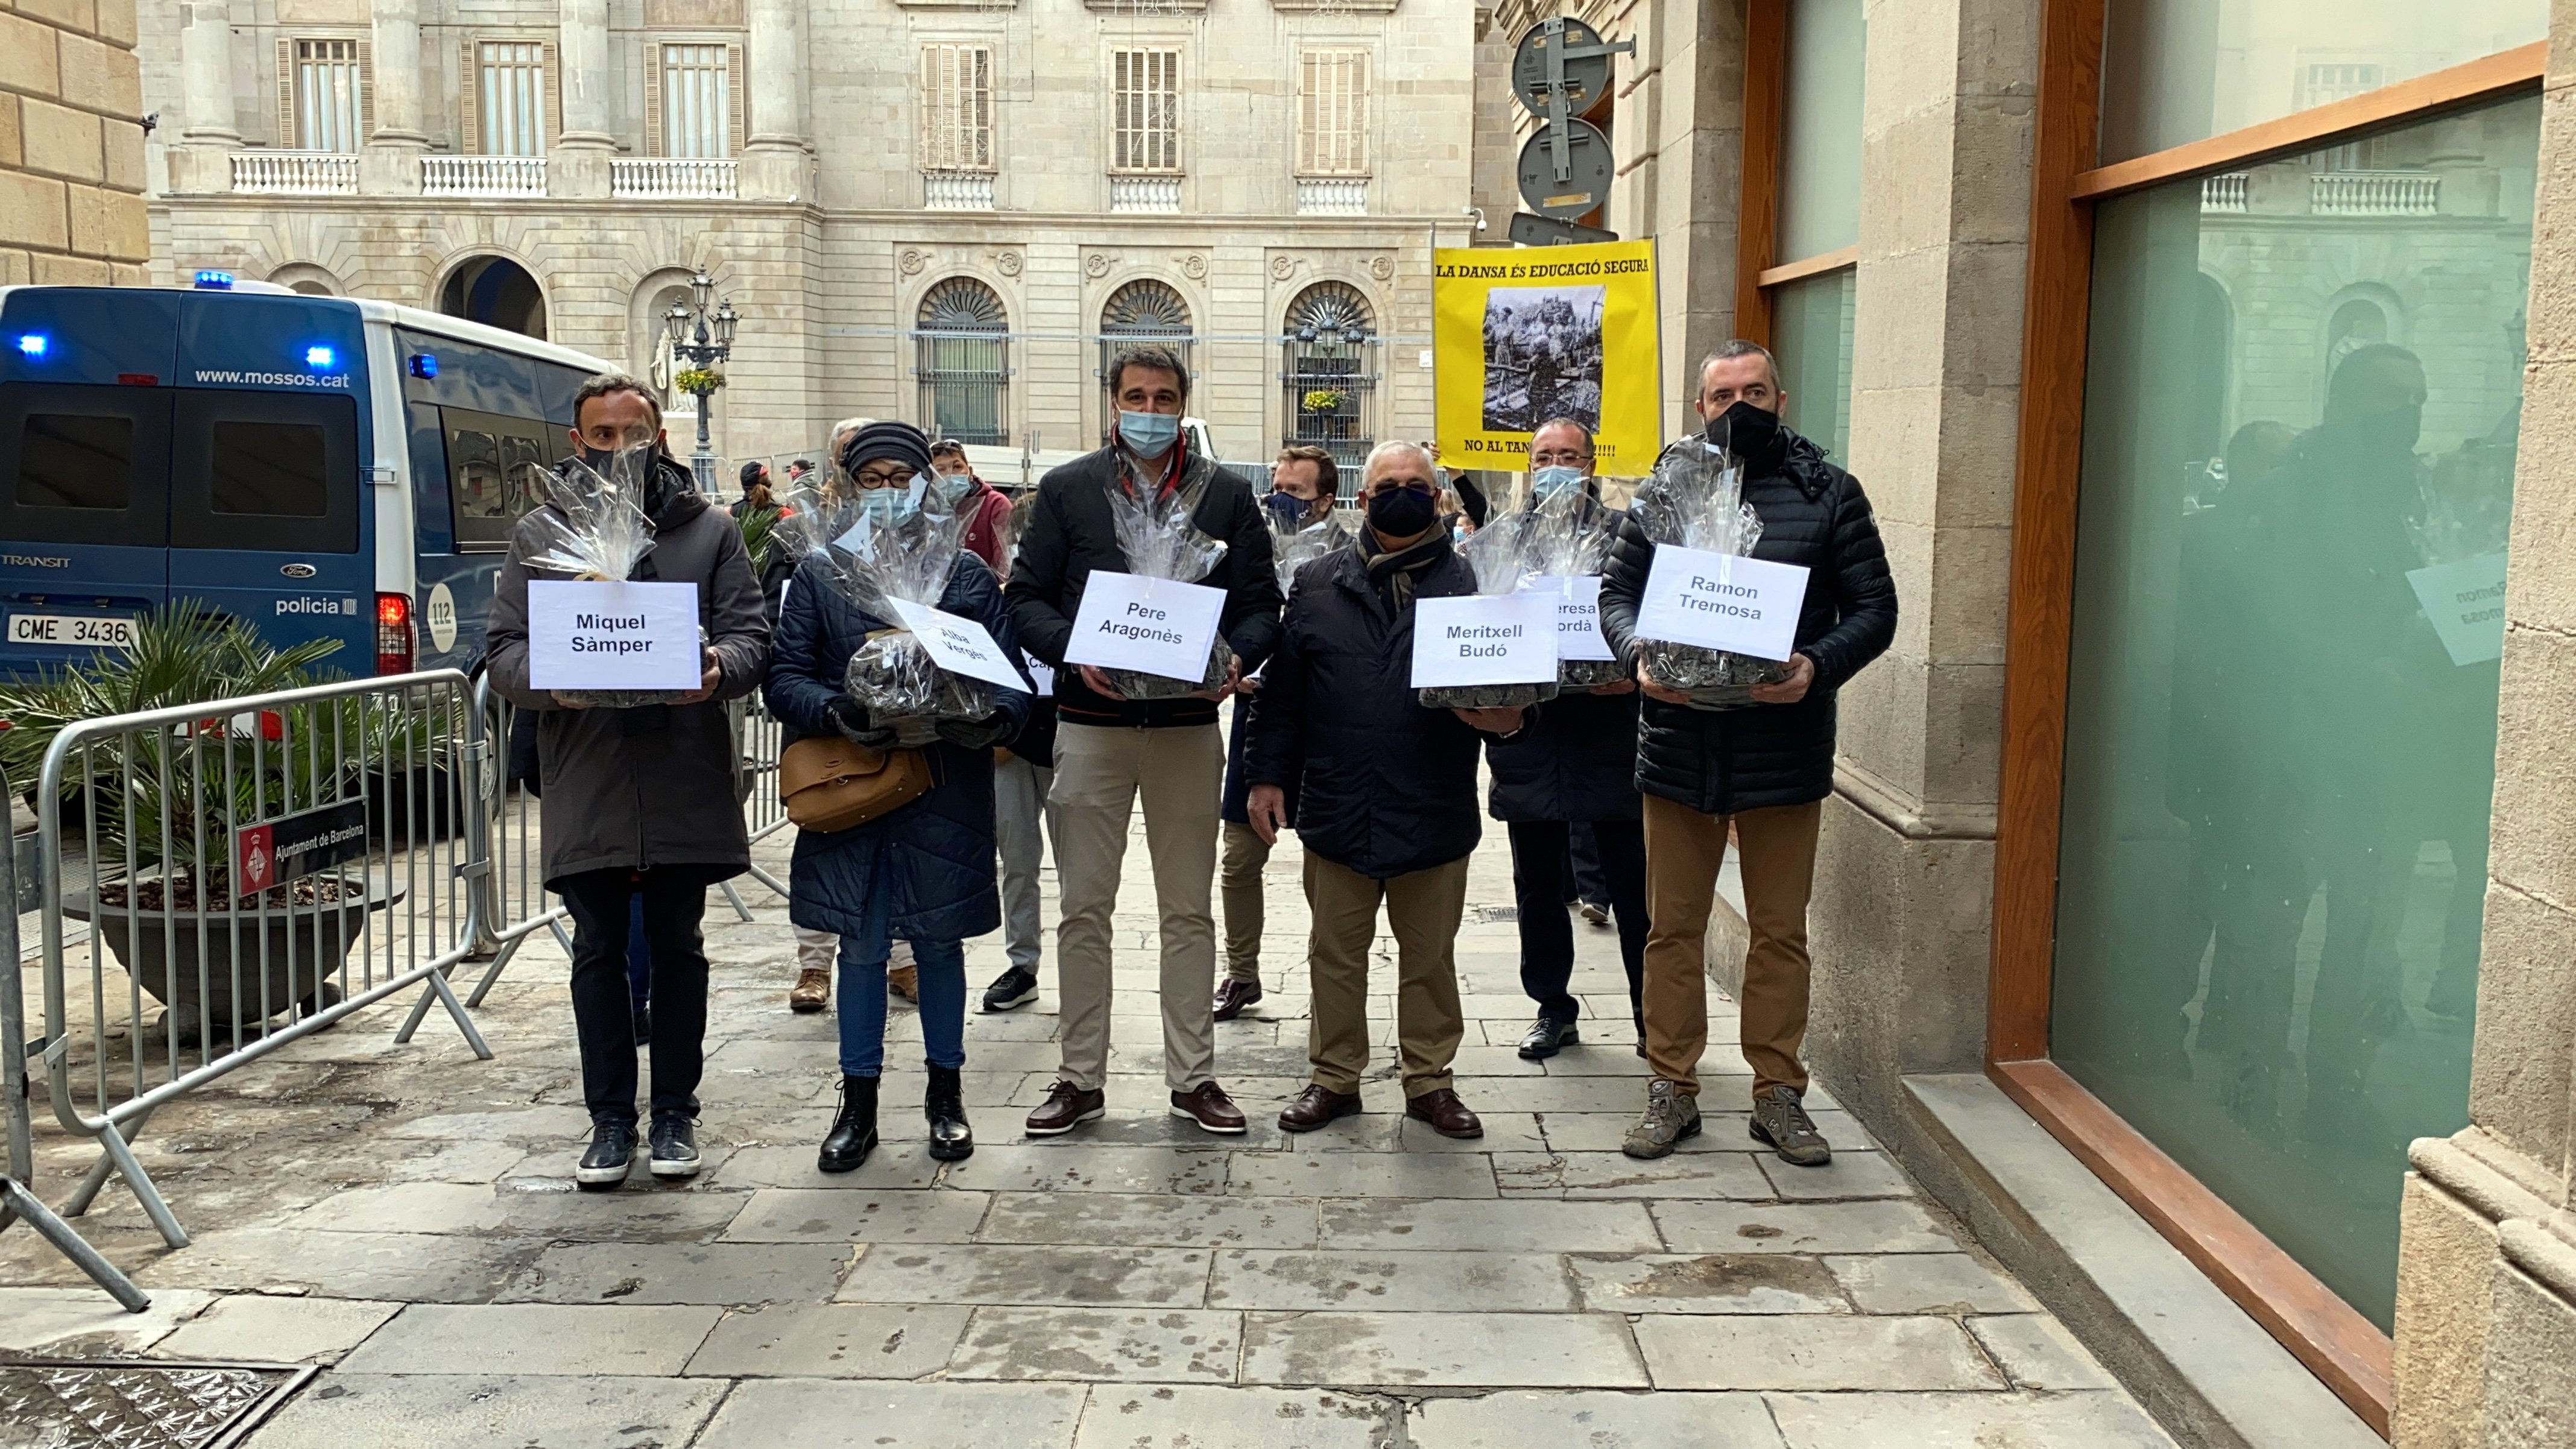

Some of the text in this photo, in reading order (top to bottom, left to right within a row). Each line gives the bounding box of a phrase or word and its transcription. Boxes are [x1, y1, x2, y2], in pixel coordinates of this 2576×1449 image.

[1436, 259, 1649, 278] LA DANSA ÉS EDUCACIÓ SEGURA
[195, 370, 350, 388] www.mossos.cat
[1464, 440, 1483, 451] NO
[1486, 441, 1503, 452] AL
[1505, 441, 1530, 453] TAN
[0, 554, 71, 568] TRANSIT
[287, 566, 308, 575] Ford
[1691, 575, 1759, 599] Ramon
[276, 596, 339, 616] policia
[432, 602, 451, 625] 112
[1126, 602, 1166, 620] Pere
[1679, 593, 1763, 620] Tremosa
[18, 619, 128, 643] CME 3436
[576, 614, 645, 633] Miquel
[1099, 619, 1182, 645] Aragonès
[1447, 625, 1523, 639] Meritxell
[1558, 619, 1592, 632] ordà
[941, 627, 970, 645] Alba
[572, 637, 653, 655] Sàmper
[1459, 643, 1507, 657] Budó
[275, 825, 364, 862] Ajuntament de Barcelona
